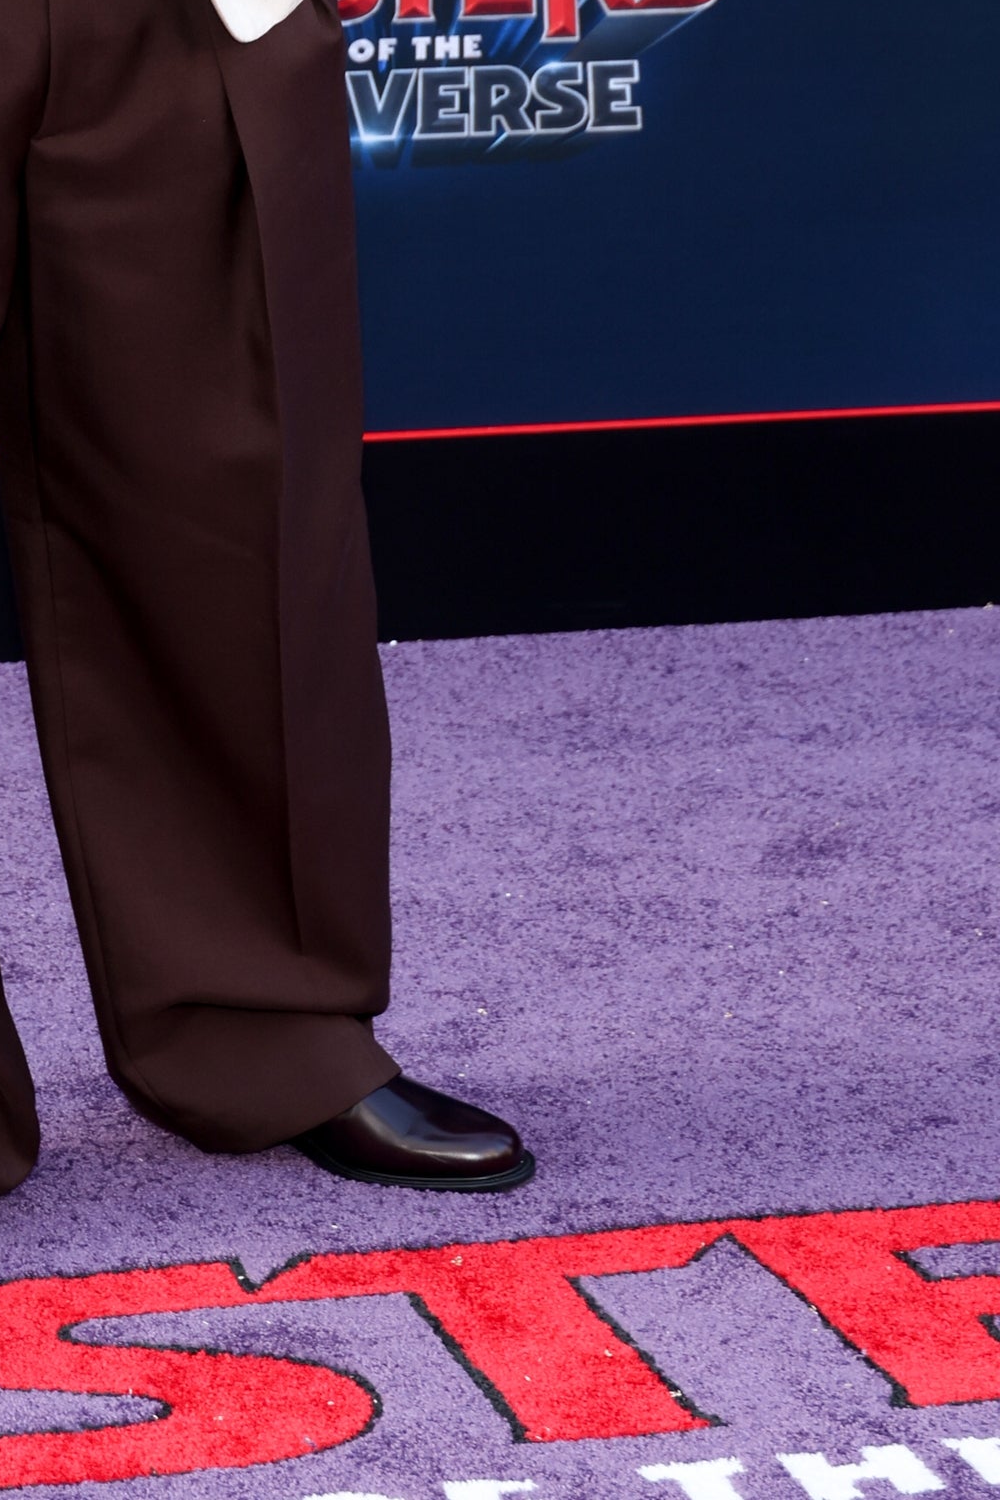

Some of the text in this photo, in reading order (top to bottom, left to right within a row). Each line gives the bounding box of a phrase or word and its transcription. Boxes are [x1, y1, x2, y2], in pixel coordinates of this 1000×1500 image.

[348, 35, 482, 63] OF THE
[345, 59, 643, 141] VERSE
